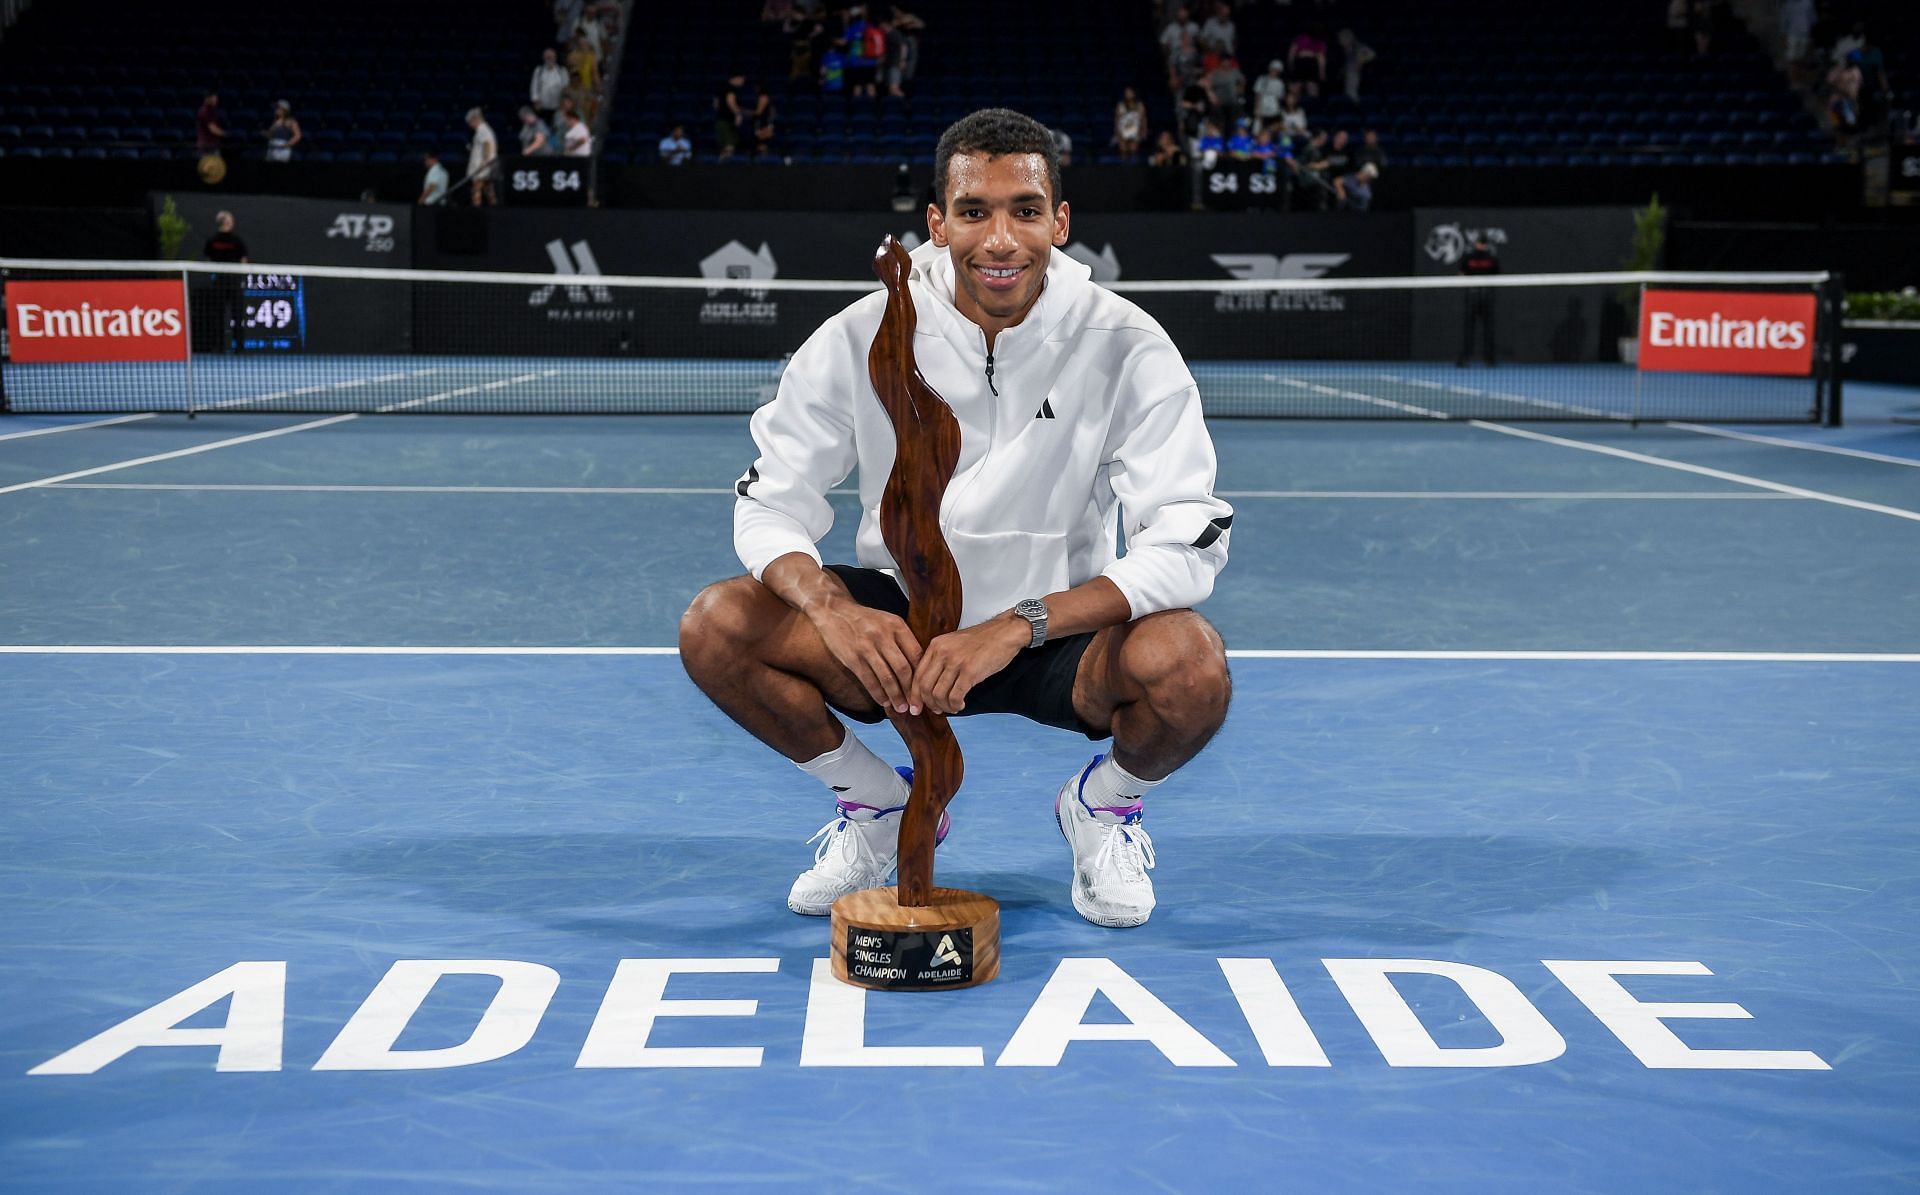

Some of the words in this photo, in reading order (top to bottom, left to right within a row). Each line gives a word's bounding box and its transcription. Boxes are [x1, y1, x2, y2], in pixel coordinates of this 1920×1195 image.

[513, 171, 539, 190] S5
[552, 171, 580, 190] S4
[1209, 173, 1238, 193] S4
[1249, 173, 1277, 193] S3
[326, 213, 394, 240] ATP
[365, 237, 394, 252] 250
[16, 301, 182, 338] Emirates
[241, 299, 292, 329] :49
[1650, 312, 1805, 350] Emirates
[854, 935, 883, 948] MEN'S
[854, 950, 892, 964] SINGLES
[854, 964, 907, 980] CHAMPION
[917, 968, 962, 979] ADELAIDE
[28, 957, 1833, 1076] ADELAIDE
